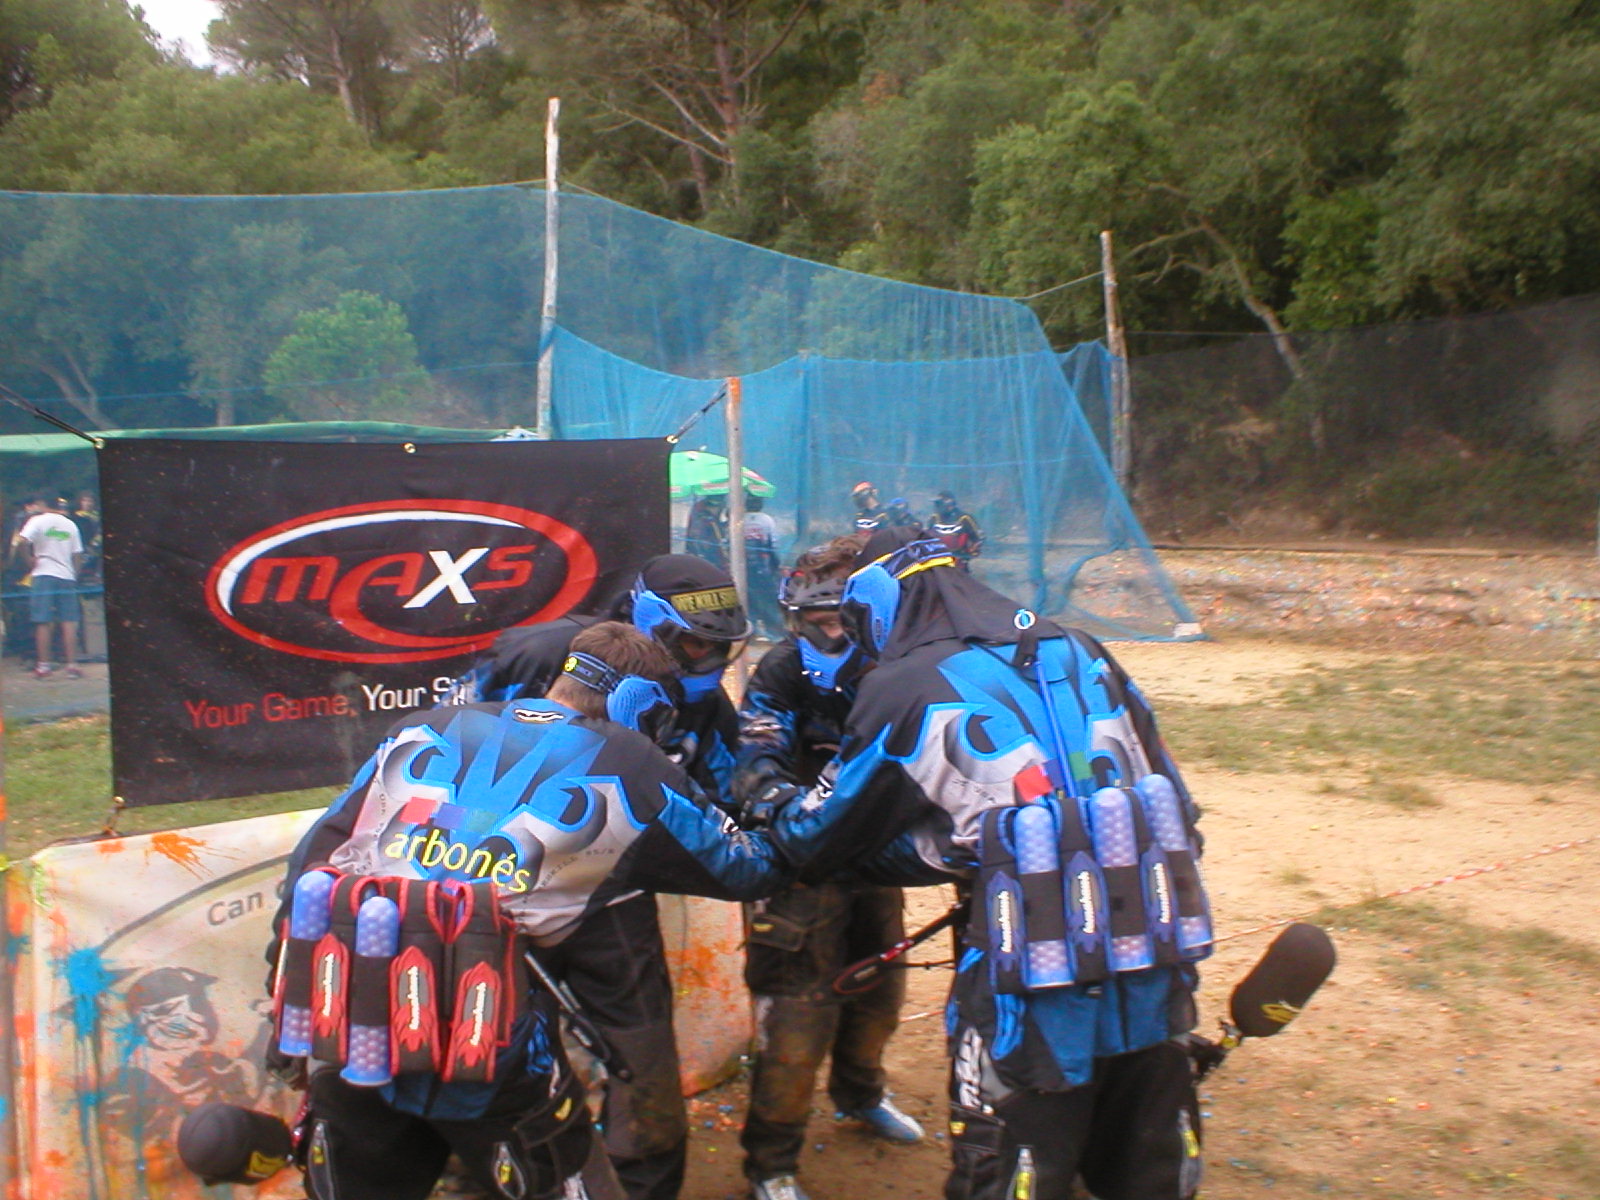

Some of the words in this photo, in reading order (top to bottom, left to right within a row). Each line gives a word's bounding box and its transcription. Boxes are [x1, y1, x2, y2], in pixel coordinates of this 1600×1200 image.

[183, 699, 256, 729] Your
[361, 683, 427, 711] Your
[384, 829, 531, 893] arbonés
[208, 892, 264, 926] Can
